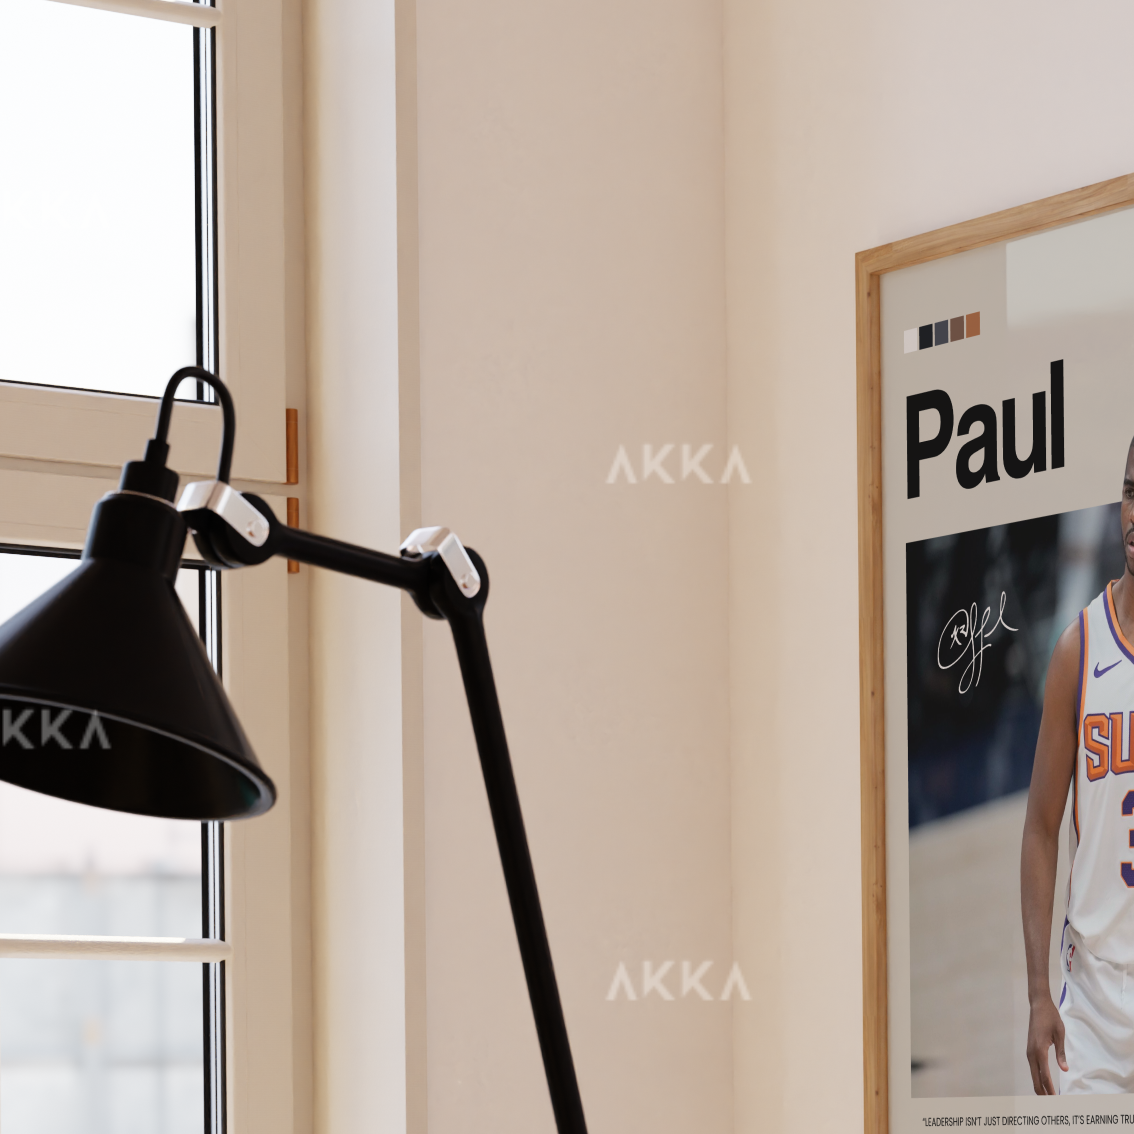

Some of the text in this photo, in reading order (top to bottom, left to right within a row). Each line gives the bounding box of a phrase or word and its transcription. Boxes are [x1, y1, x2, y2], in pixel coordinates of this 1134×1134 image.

[906, 359, 1065, 499] Paul
[922, 1117, 963, 1126] "LEADERSHIP
[965, 1117, 981, 1126] ISN'T
[984, 1116, 1000, 1126] JUST
[1002, 1116, 1039, 1126] DIRECTING
[1041, 1116, 1070, 1127] OTHERS,
[1072, 1115, 1084, 1125] IT'S
[1086, 1115, 1118, 1124] EARNING
